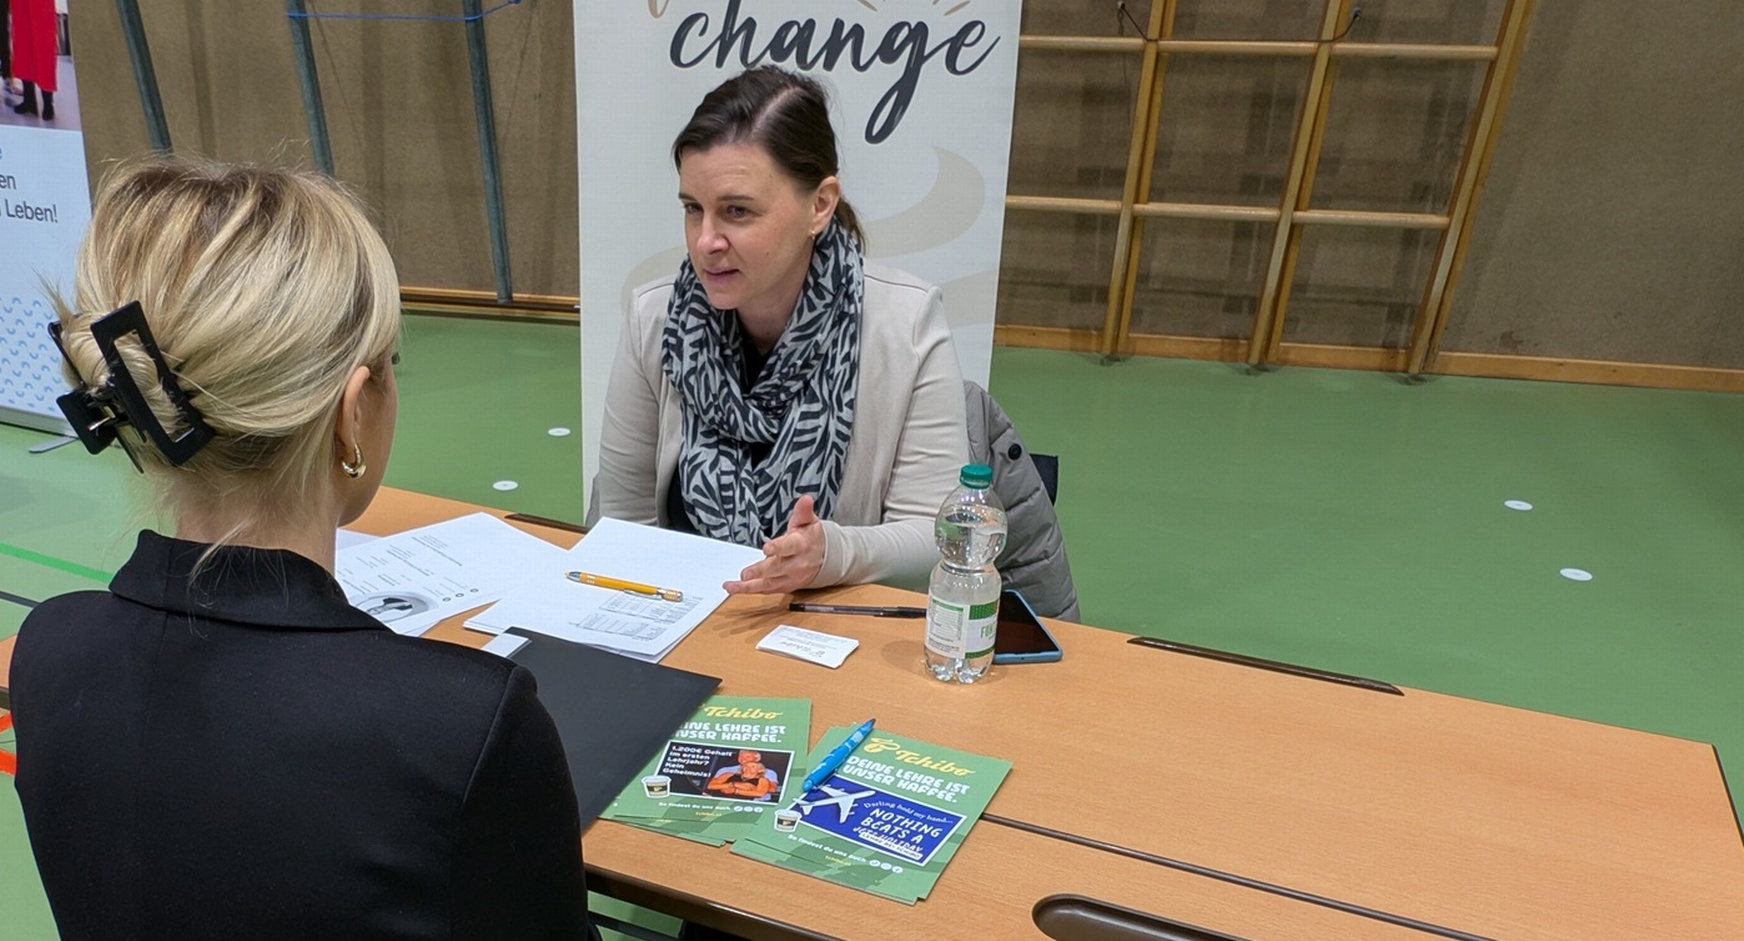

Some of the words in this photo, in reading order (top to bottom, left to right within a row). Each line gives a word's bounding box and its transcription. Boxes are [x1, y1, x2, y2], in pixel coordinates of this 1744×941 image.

[670, 0, 1001, 145] change
[4, 198, 59, 223] Leben!
[703, 706, 784, 720] Tchibo
[714, 723, 760, 734] LEHRE
[764, 725, 787, 735] IST
[667, 756, 710, 766] Lehrjahr?
[704, 749, 733, 757] Gehalt
[895, 750, 976, 777] Tchibo
[662, 767, 712, 777] Geheimnis!
[842, 764, 895, 786] UNSER
[846, 755, 895, 775] DEINE
[895, 769, 944, 789] LEHRE
[945, 781, 970, 795] IST
[863, 800, 896, 809] Darling
[896, 804, 914, 815] hold
[913, 812, 926, 820] my
[860, 816, 911, 840] BEATS
[911, 834, 924, 845] A
[869, 808, 943, 838] NOTHING
